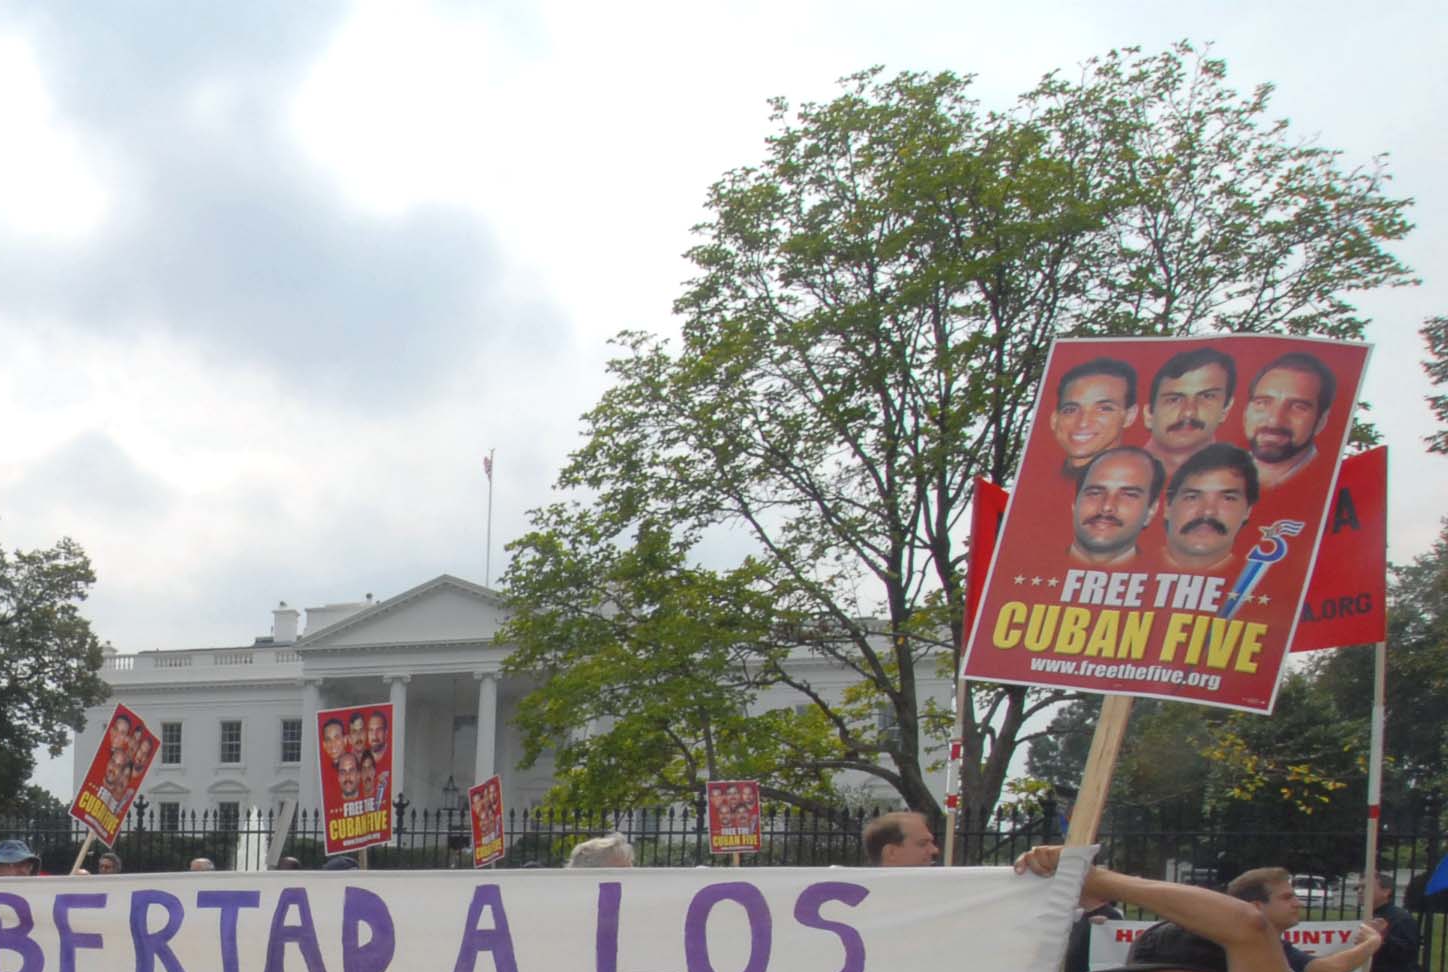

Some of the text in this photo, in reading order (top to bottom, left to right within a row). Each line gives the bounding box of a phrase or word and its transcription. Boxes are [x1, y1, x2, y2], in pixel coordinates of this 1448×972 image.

[1060, 568, 1226, 614] FREE THE
[992, 601, 1269, 674] CUBAN FIVE
[1030, 655, 1222, 691] www.freethefive.org
